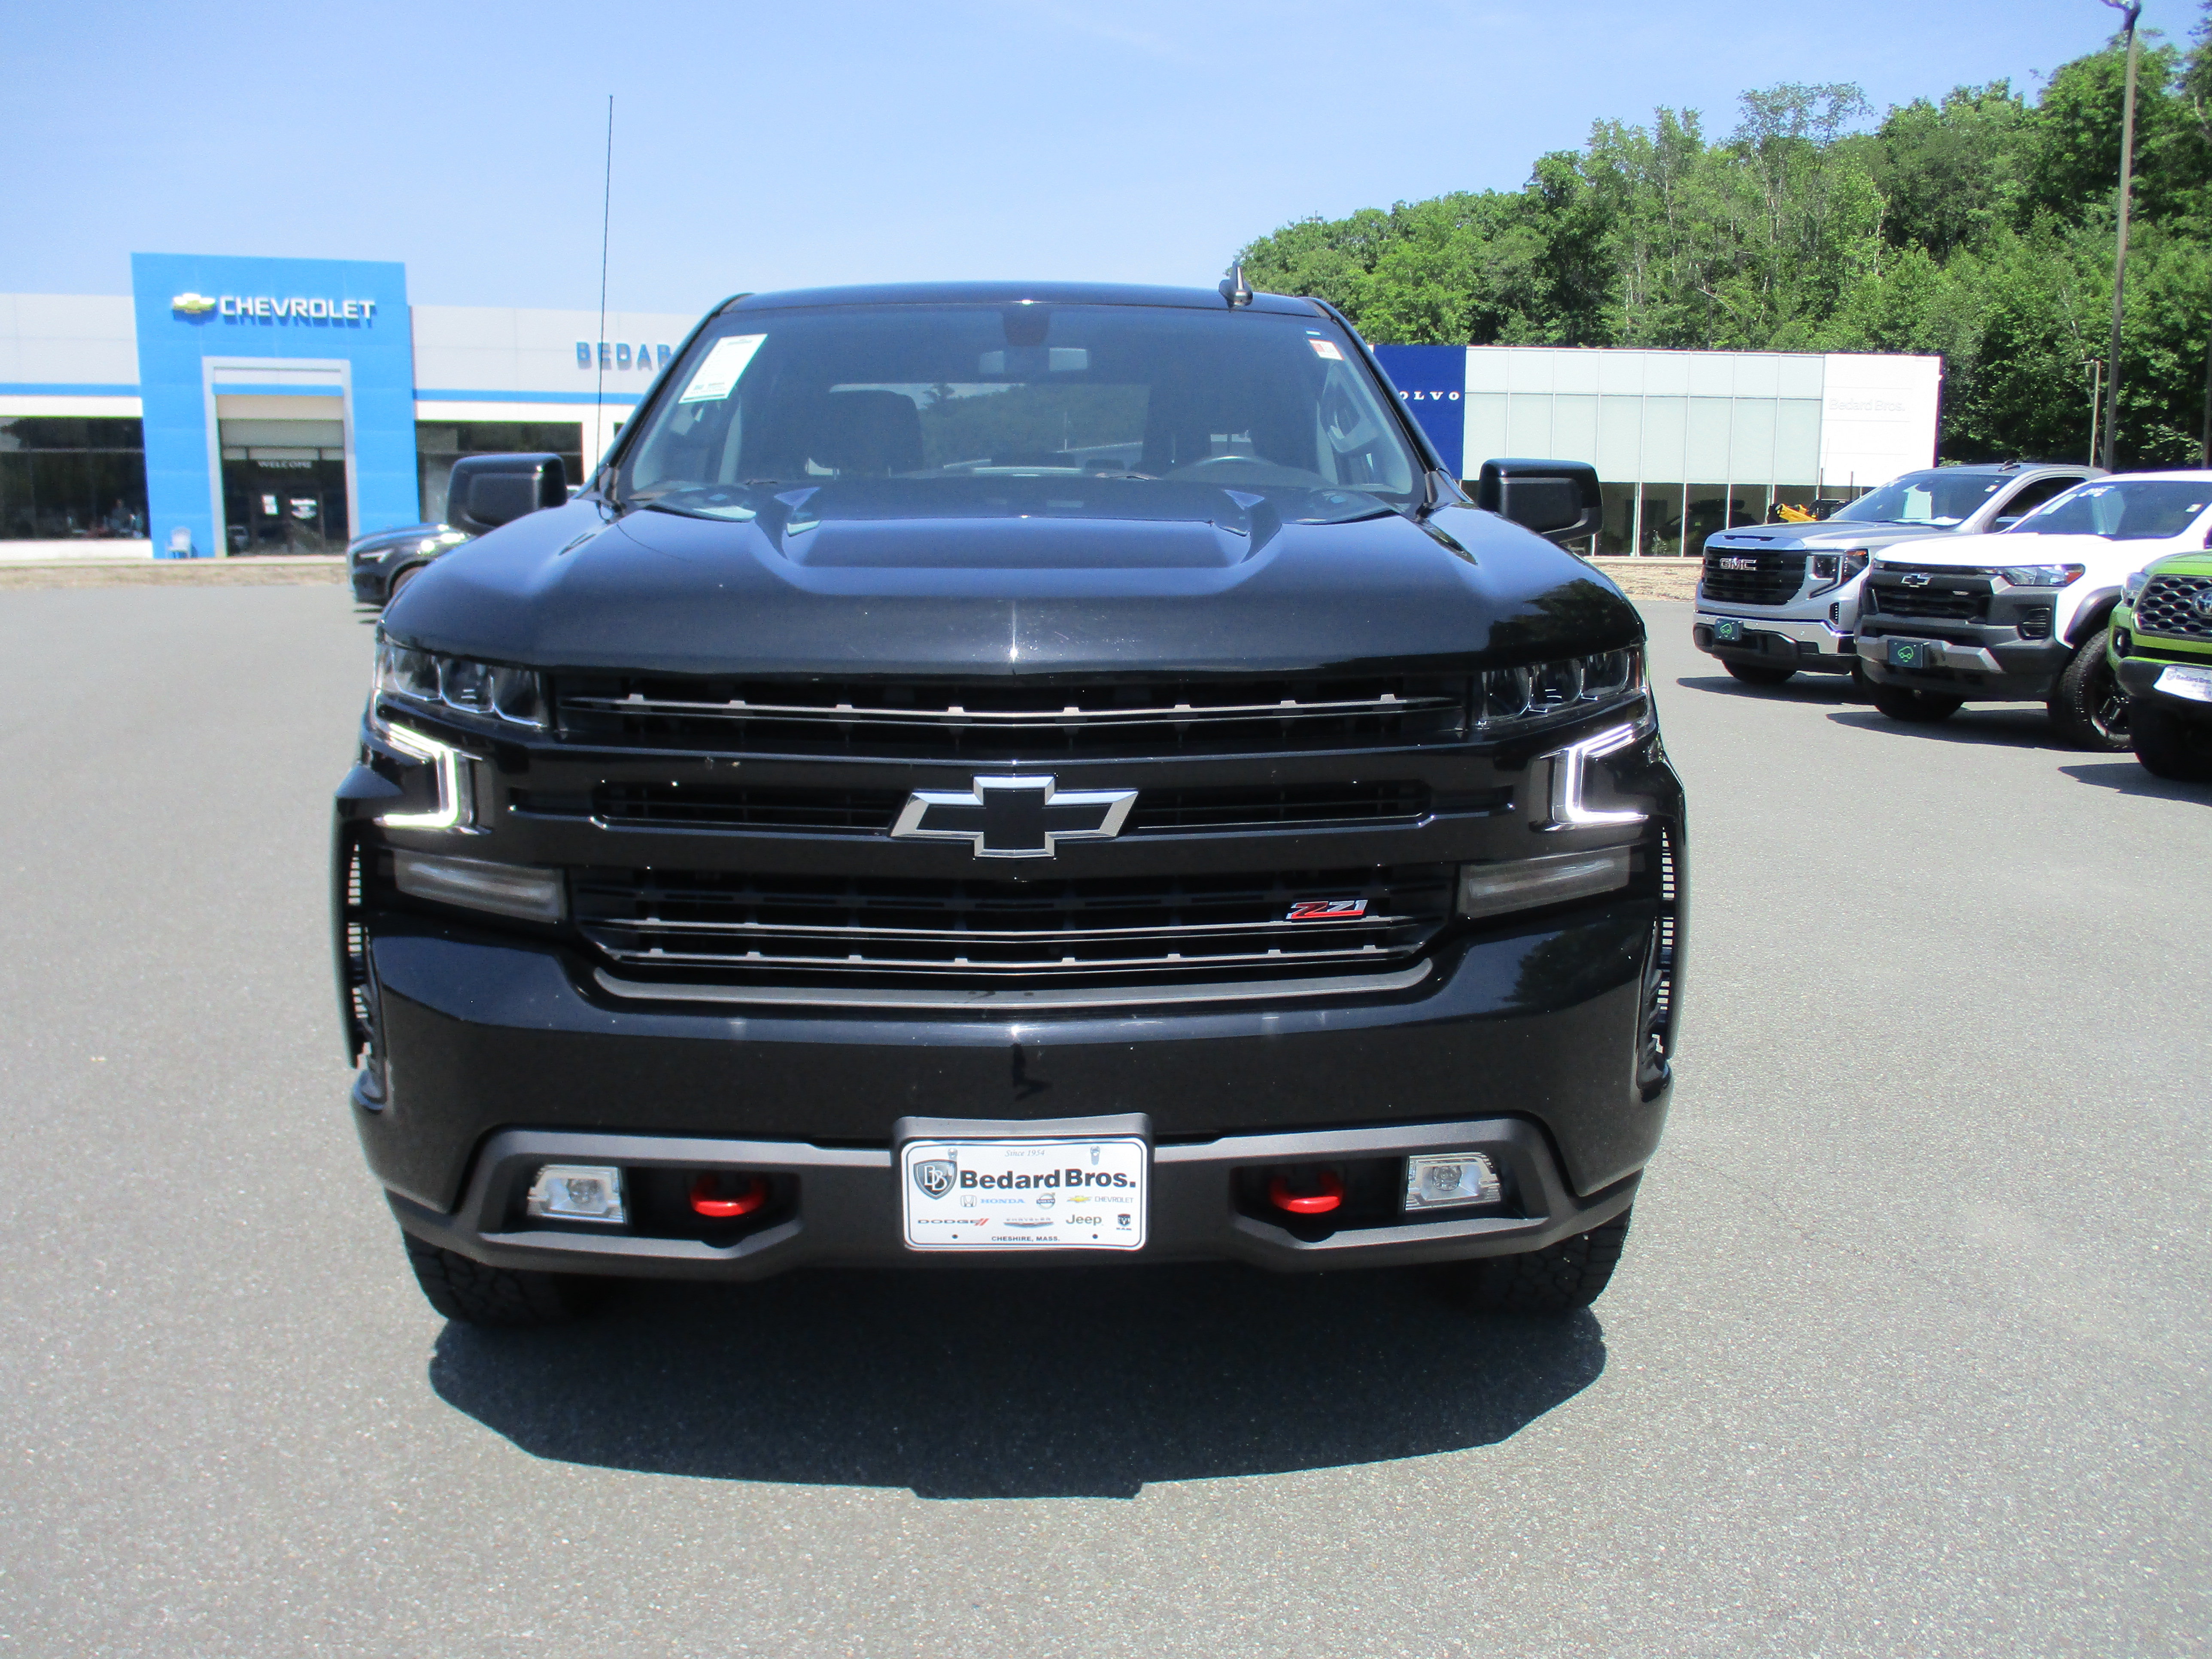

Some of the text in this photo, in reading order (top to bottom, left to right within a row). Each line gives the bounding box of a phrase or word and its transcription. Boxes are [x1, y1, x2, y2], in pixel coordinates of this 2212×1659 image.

[219, 296, 375, 319] CHEVROLET
[576, 341, 672, 363] BEDAR
[1399, 391, 1460, 400] OLVO
[1829, 398, 1905, 411] Bedard Bros.
[1720, 558, 1757, 571] GMC
[1286, 899, 1368, 919] Z71
[960, 1168, 1136, 1189] Bedard Bros.
[1065, 1214, 1103, 1226] Jeep
